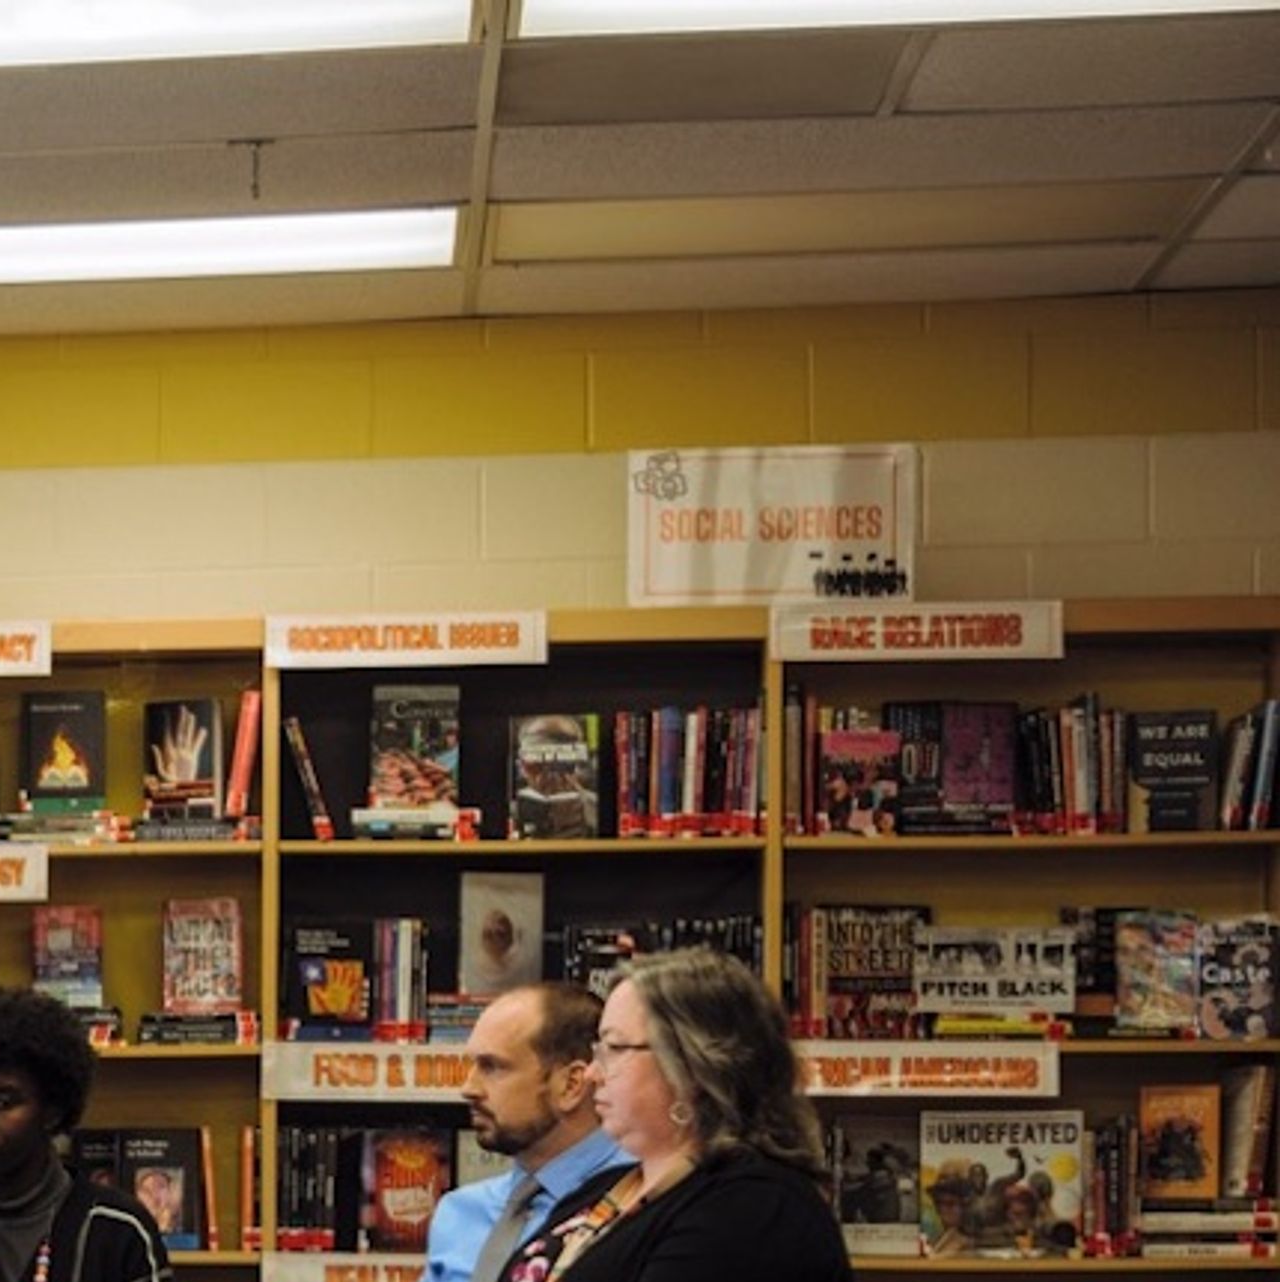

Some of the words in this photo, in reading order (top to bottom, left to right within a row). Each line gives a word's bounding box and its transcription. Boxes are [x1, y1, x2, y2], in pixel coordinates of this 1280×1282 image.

[660, 509, 745, 541] SOCIAL
[758, 506, 883, 541] SCIENCES
[288, 625, 442, 652] SOCIOPOLITICAL
[448, 622, 520, 650] ISSUES
[810, 614, 876, 650] RACE
[882, 613, 1024, 648] RELATIONS
[1142, 752, 1206, 770] EQUAL
[921, 981, 989, 997] PITCH
[997, 979, 1068, 996] BLACK
[1202, 961, 1271, 985] Caste
[312, 1053, 377, 1087] FOOD
[385, 1053, 405, 1087] &
[898, 1056, 1038, 1088] AMERICANS
[937, 1122, 1078, 1145] UNDEFEATED
